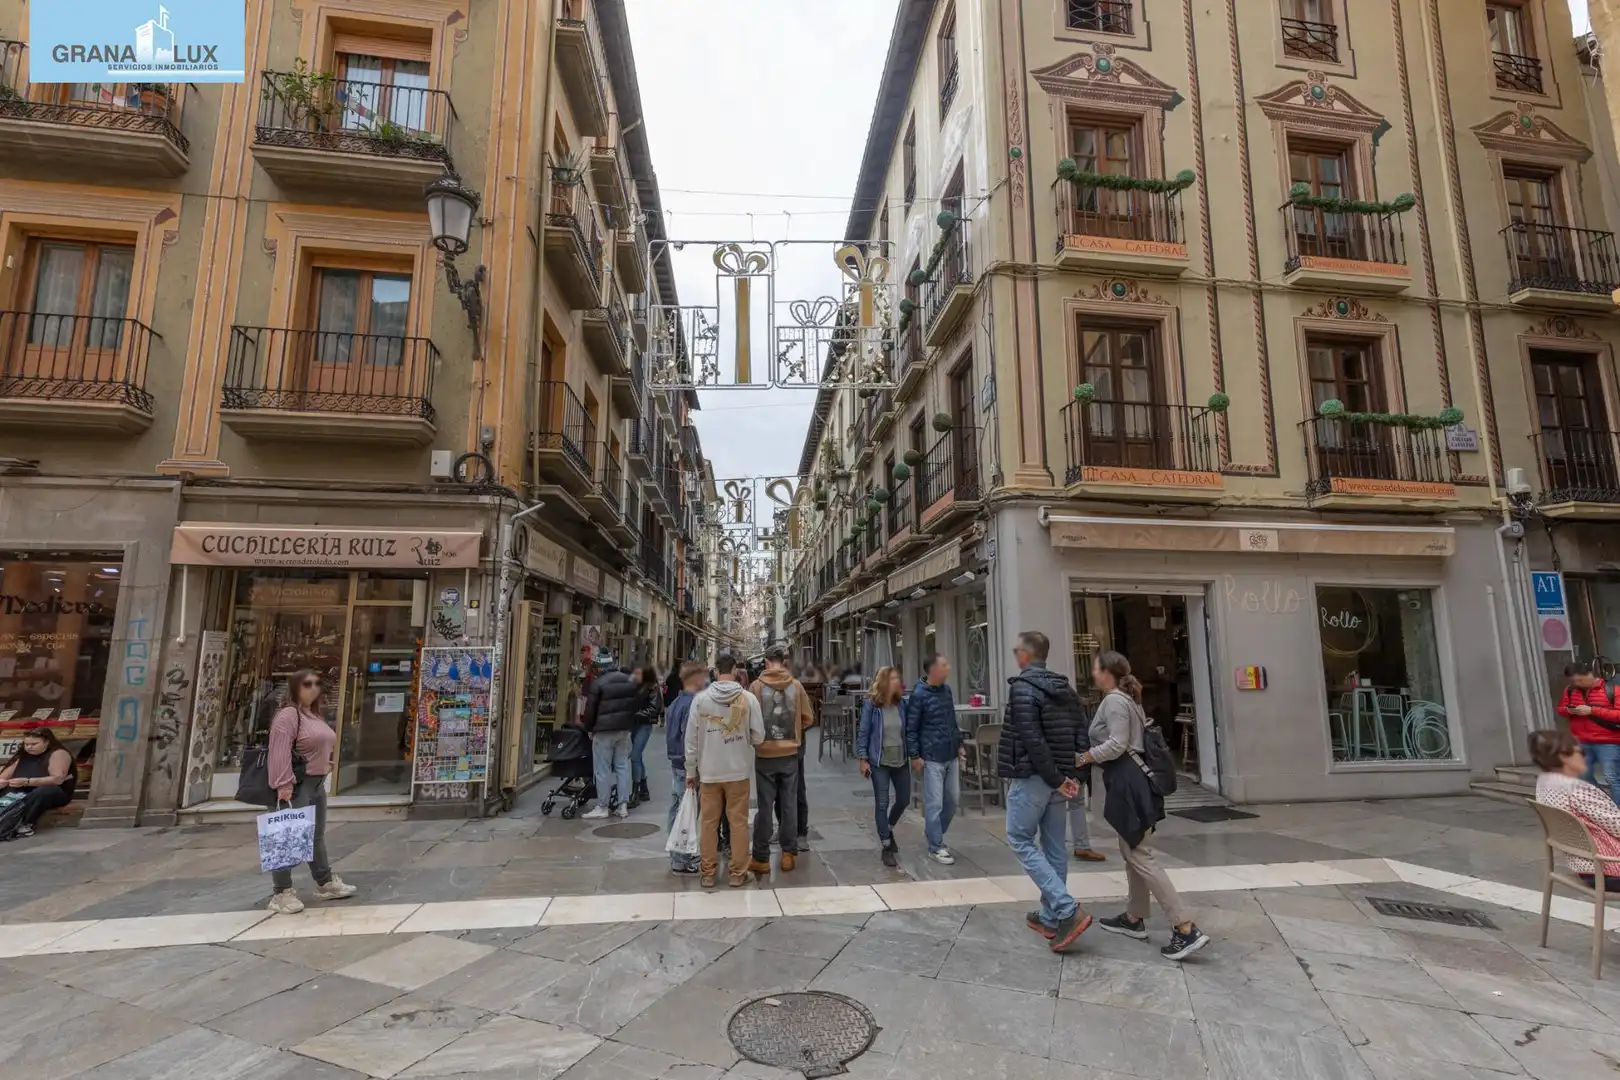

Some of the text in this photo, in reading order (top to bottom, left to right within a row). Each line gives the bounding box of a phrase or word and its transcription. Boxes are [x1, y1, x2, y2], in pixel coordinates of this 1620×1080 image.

[1080, 239, 1112, 249] CASA
[1100, 470, 1137, 481] CASA
[201, 532, 397, 557] CUCHILLERÍA RUIZ
[1537, 576, 1556, 593] AT
[1224, 574, 1308, 615] Rollo
[1320, 606, 1363, 628] Rollo
[268, 812, 305, 824] FRIKING
